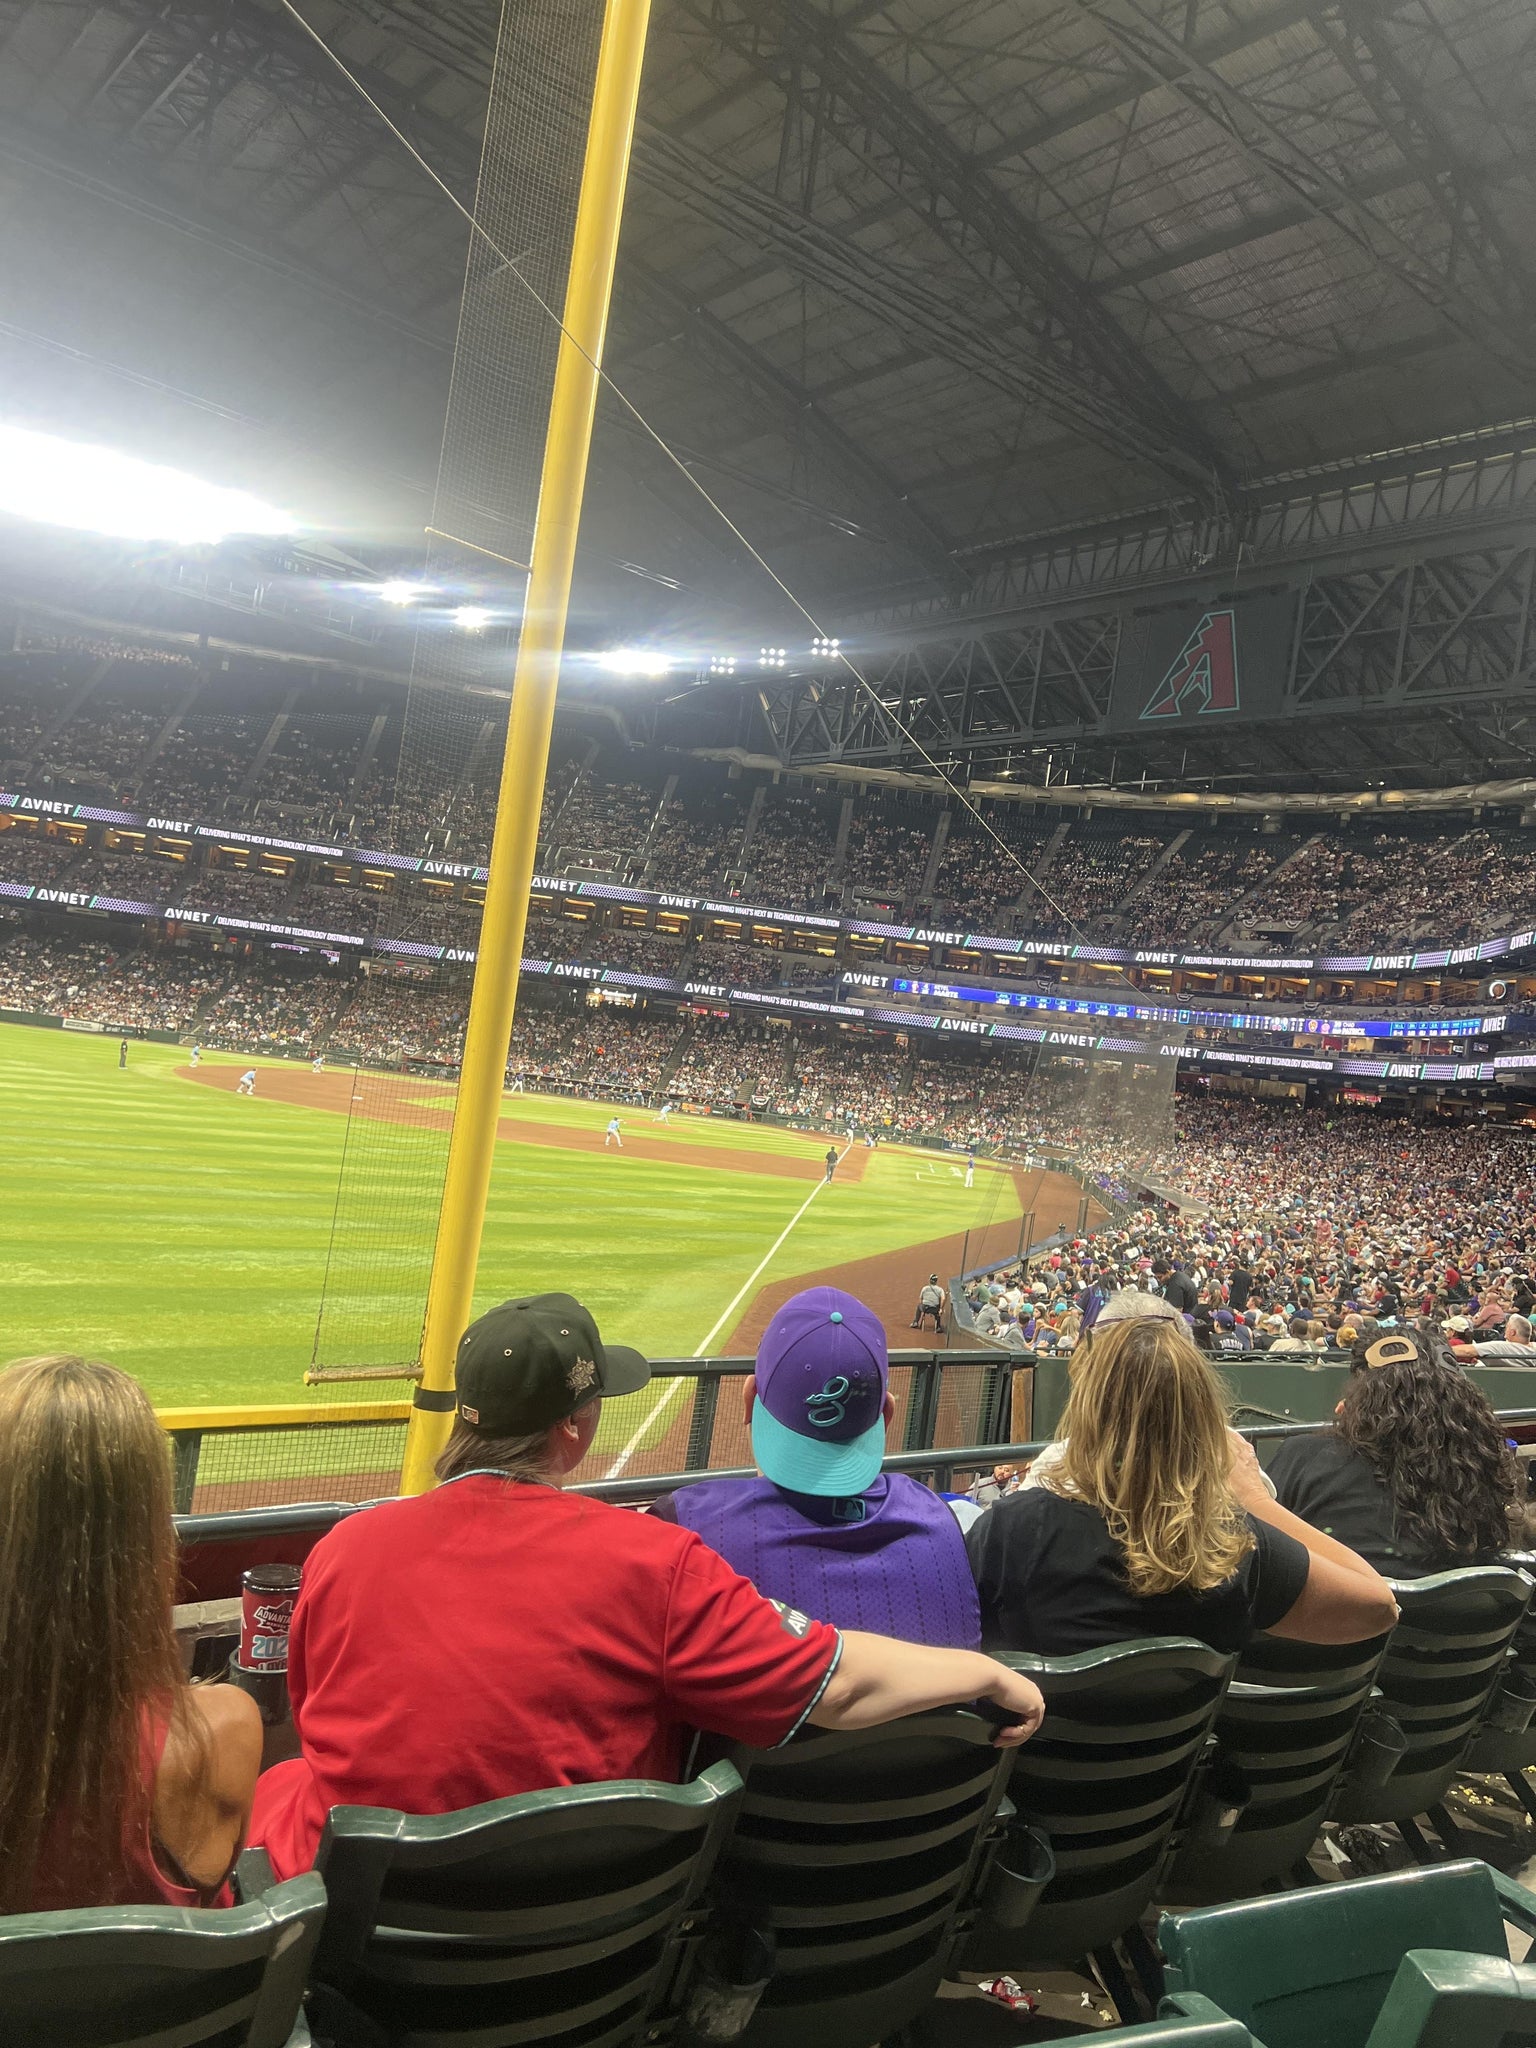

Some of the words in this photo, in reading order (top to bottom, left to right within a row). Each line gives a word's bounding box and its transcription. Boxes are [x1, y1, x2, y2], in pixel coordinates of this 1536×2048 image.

[21, 798, 73, 815] AVNET
[147, 818, 192, 833] AVNET
[424, 861, 472, 877] AVNET
[531, 877, 577, 892] AVNET
[36, 888, 90, 906] AVNET
[659, 895, 700, 908] AVNET
[164, 907, 211, 923] AVNET
[916, 929, 964, 945] AVNET
[446, 949, 478, 963] AVN
[1024, 941, 1072, 956] AVNET
[1451, 946, 1479, 964] AVNET
[1135, 951, 1178, 964] AVNET
[1373, 955, 1414, 969] AVNET
[554, 963, 601, 980] AVNET
[843, 972, 888, 988] AVNET
[684, 983, 726, 997] AVNET
[941, 1018, 988, 1034] AVNET
[1049, 1032, 1097, 1048] AVNET
[1160, 1045, 1200, 1059] AVNET
[1388, 1064, 1422, 1078] AVNET
